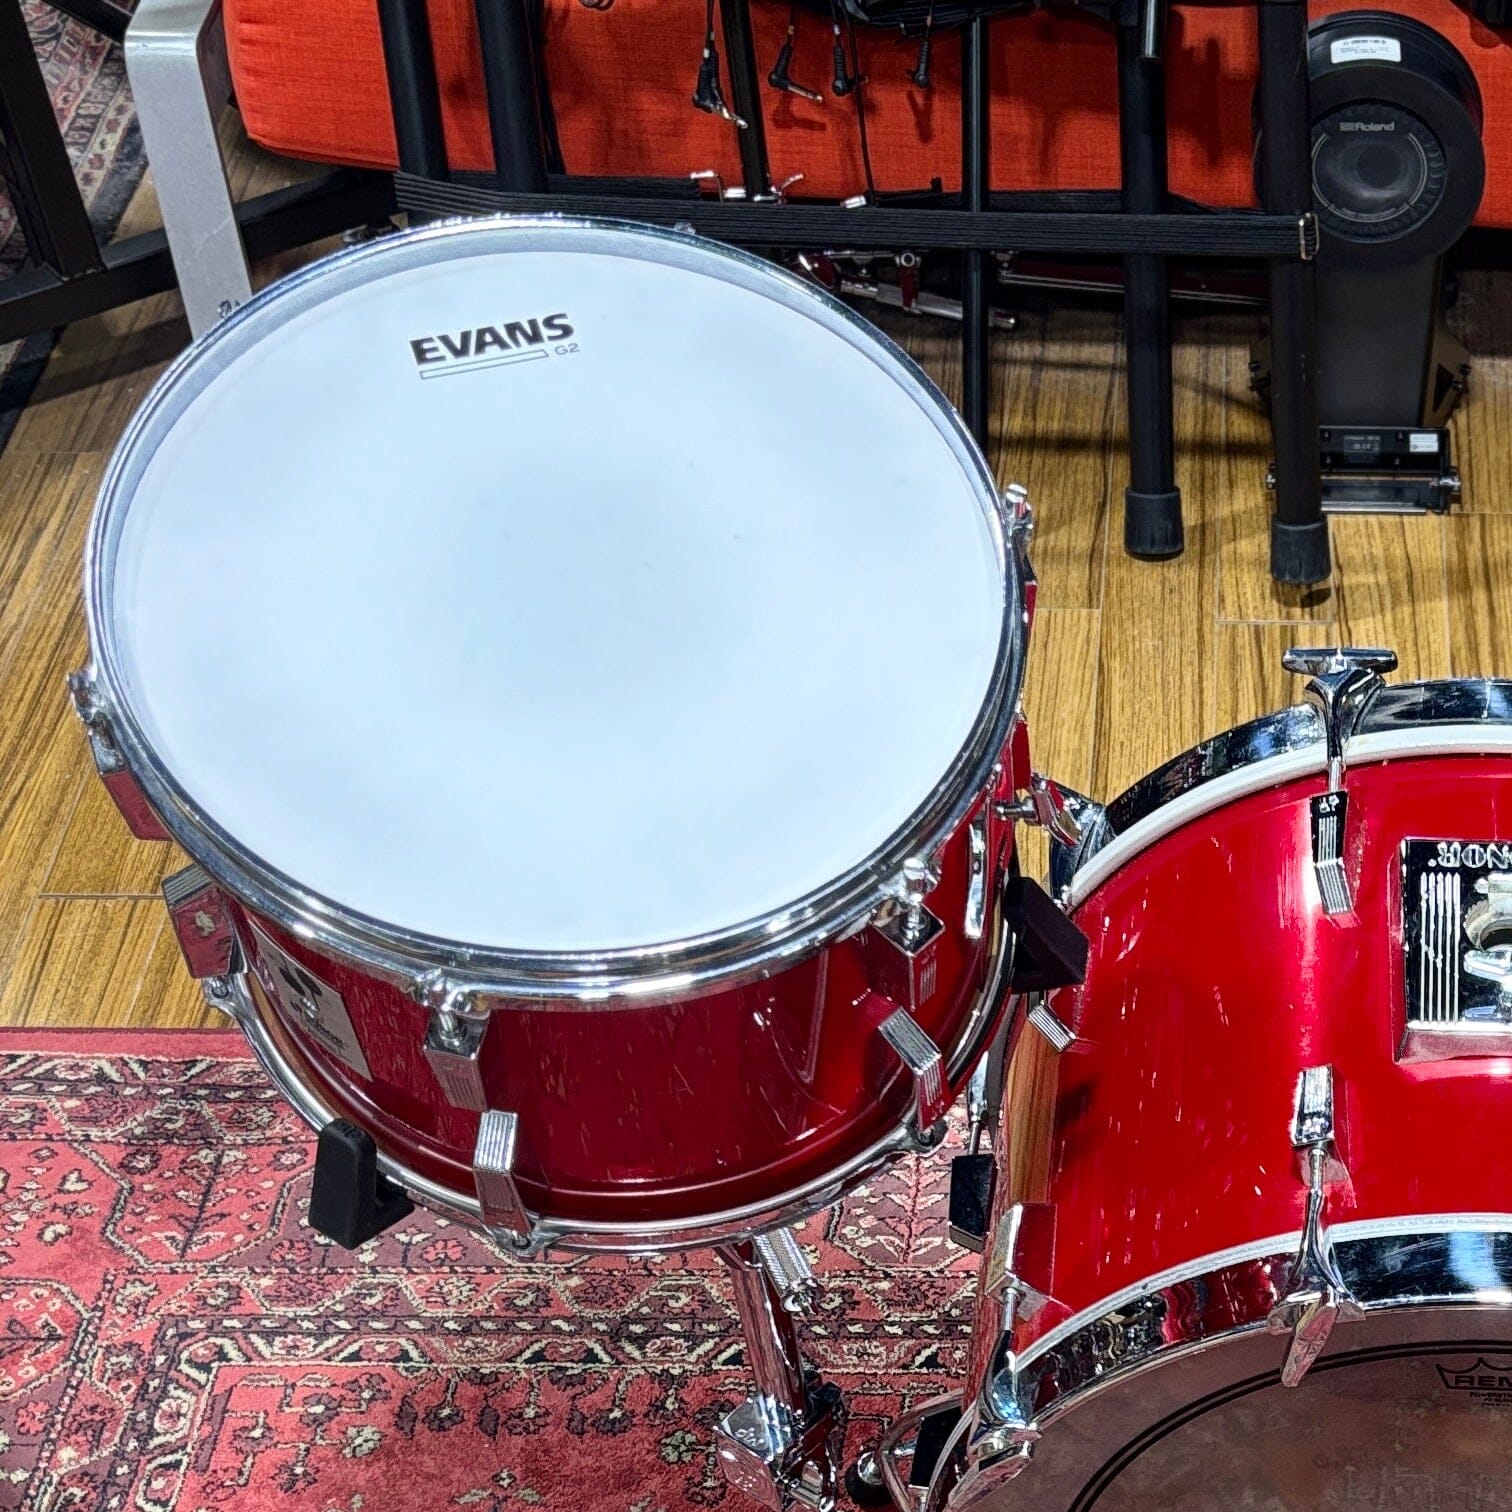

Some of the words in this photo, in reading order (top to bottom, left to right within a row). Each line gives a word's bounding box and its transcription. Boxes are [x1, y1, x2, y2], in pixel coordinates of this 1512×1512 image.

[1355, 121, 1395, 131] Roland
[409, 313, 574, 366] EVANS
[555, 342, 580, 355] G2
